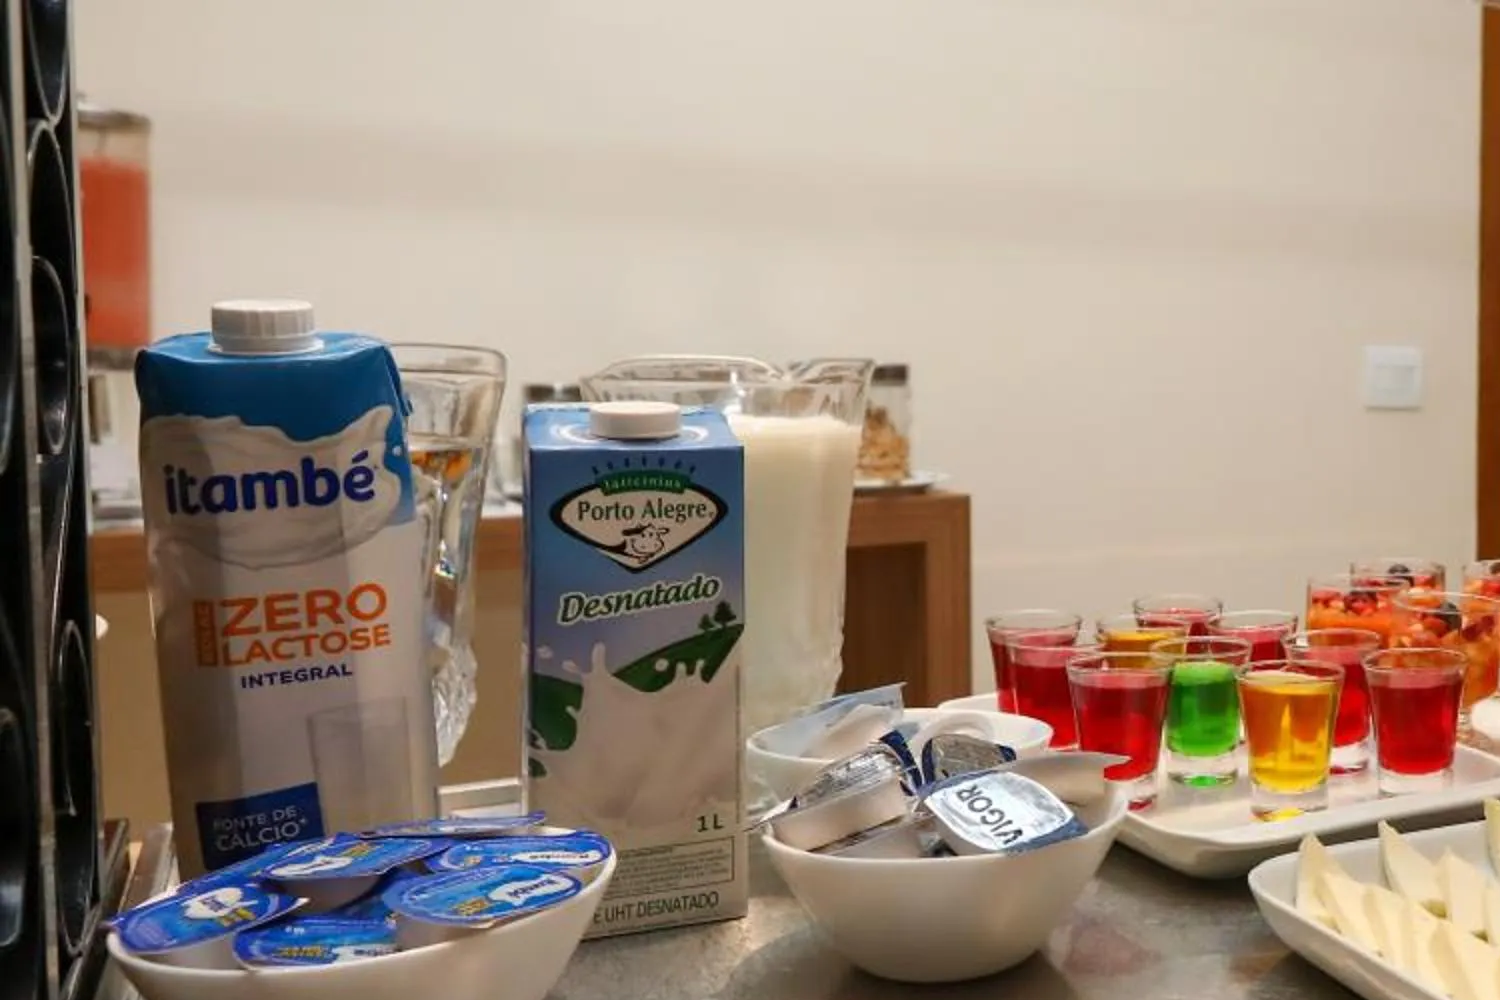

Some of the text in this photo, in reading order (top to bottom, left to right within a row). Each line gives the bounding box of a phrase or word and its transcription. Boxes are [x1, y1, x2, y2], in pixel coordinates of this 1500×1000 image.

[164, 450, 375, 515] itambé
[577, 498, 707, 524] Porto Alegre
[220, 582, 388, 637] ZERO
[558, 575, 721, 624] Desnatado
[221, 623, 391, 667] LACTOSE
[240, 663, 353, 689] INTEGRAL
[212, 805, 298, 831] FONTE DE
[956, 784, 1023, 845] VIGOR
[604, 903, 636, 922] UHT
[637, 890, 719, 918] DESNATADO
